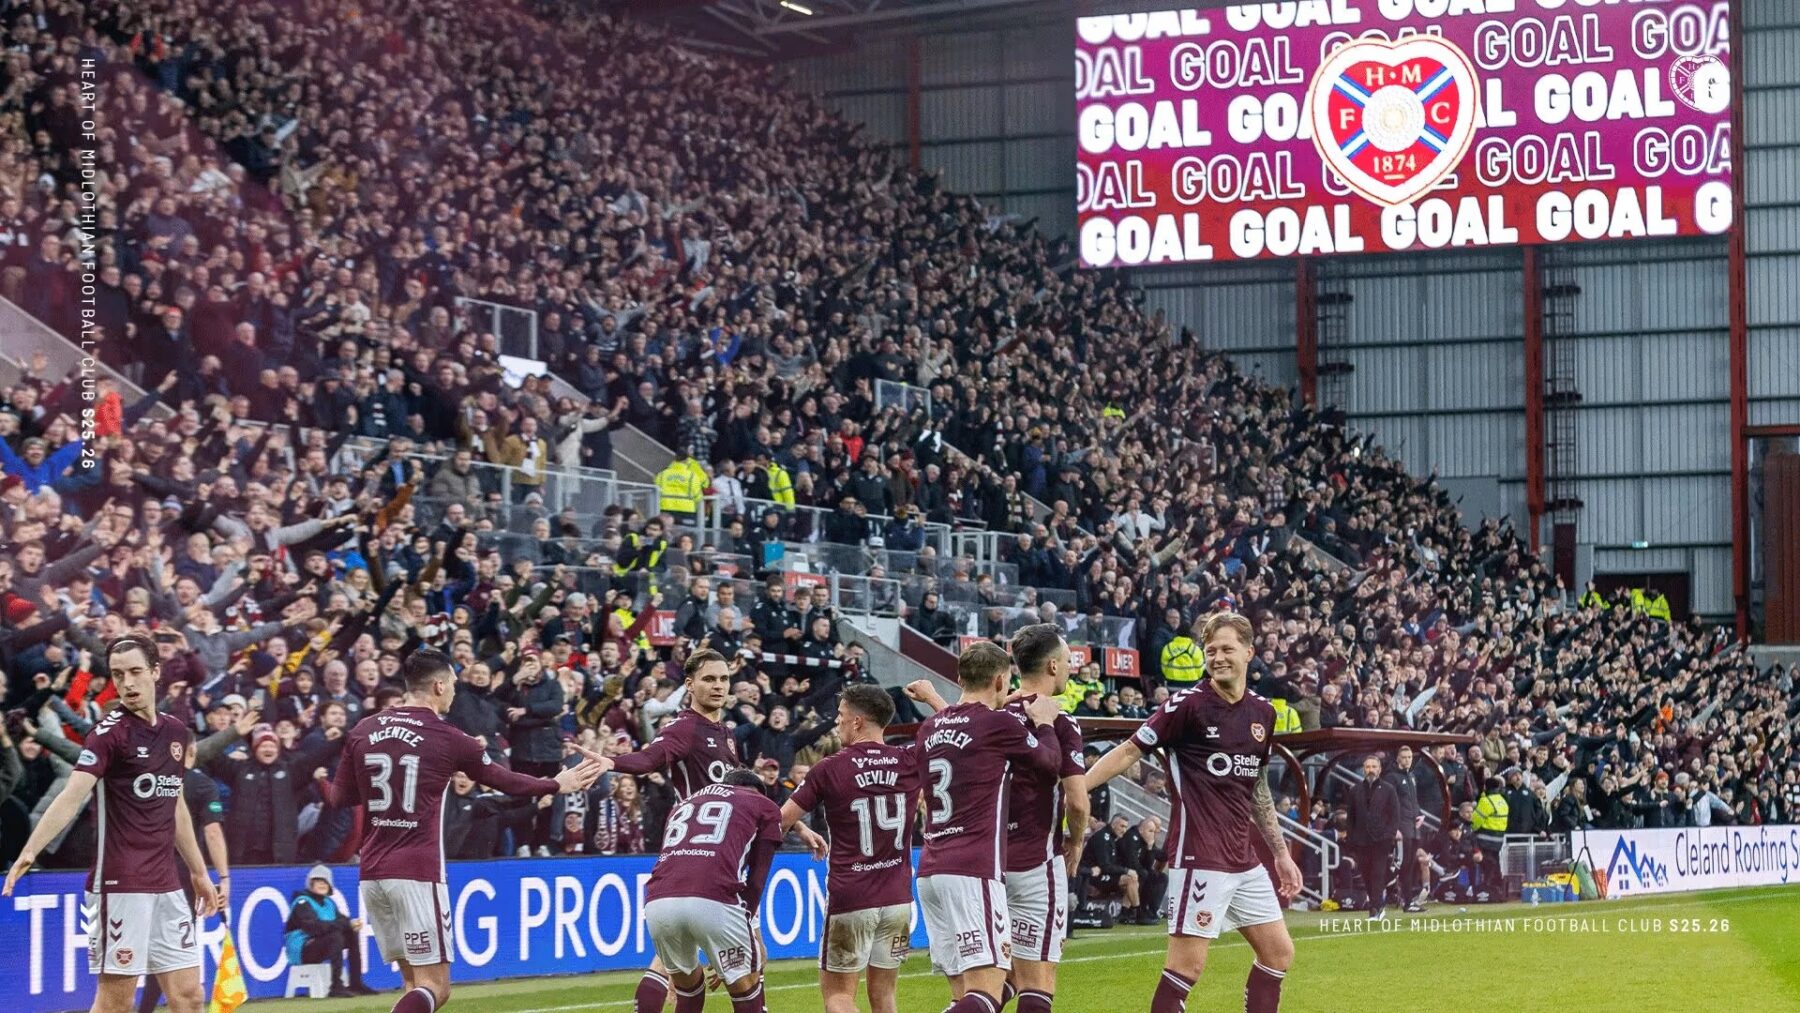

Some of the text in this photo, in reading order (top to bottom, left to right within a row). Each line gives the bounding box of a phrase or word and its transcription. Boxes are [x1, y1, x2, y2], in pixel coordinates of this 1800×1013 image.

[1170, 36, 1304, 91] GOAL
[1474, 13, 1614, 70] GOAL
[1534, 67, 1676, 125] GOAL
[1079, 99, 1212, 154] GOAL
[1172, 150, 1306, 205] GOAL
[1372, 154, 1417, 174] 1874
[1476, 131, 1616, 188] GOAL
[1080, 212, 1214, 267] GOAL
[1229, 204, 1365, 259] GOAL
[1381, 196, 1519, 251] GOAL
[1536, 185, 1678, 242] GOAL
[868, 756, 899, 766] FanHub
[924, 729, 973, 753] KINGSLEY
[364, 752, 420, 814] 31
[854, 769, 899, 789] DEVLIN
[929, 757, 953, 825] 3
[662, 801, 734, 849] 89
[850, 792, 907, 857] 14
[1675, 826, 1730, 877] Cleland
[1734, 825, 1788, 884] Roofing
[404, 930, 430, 945] PPE
